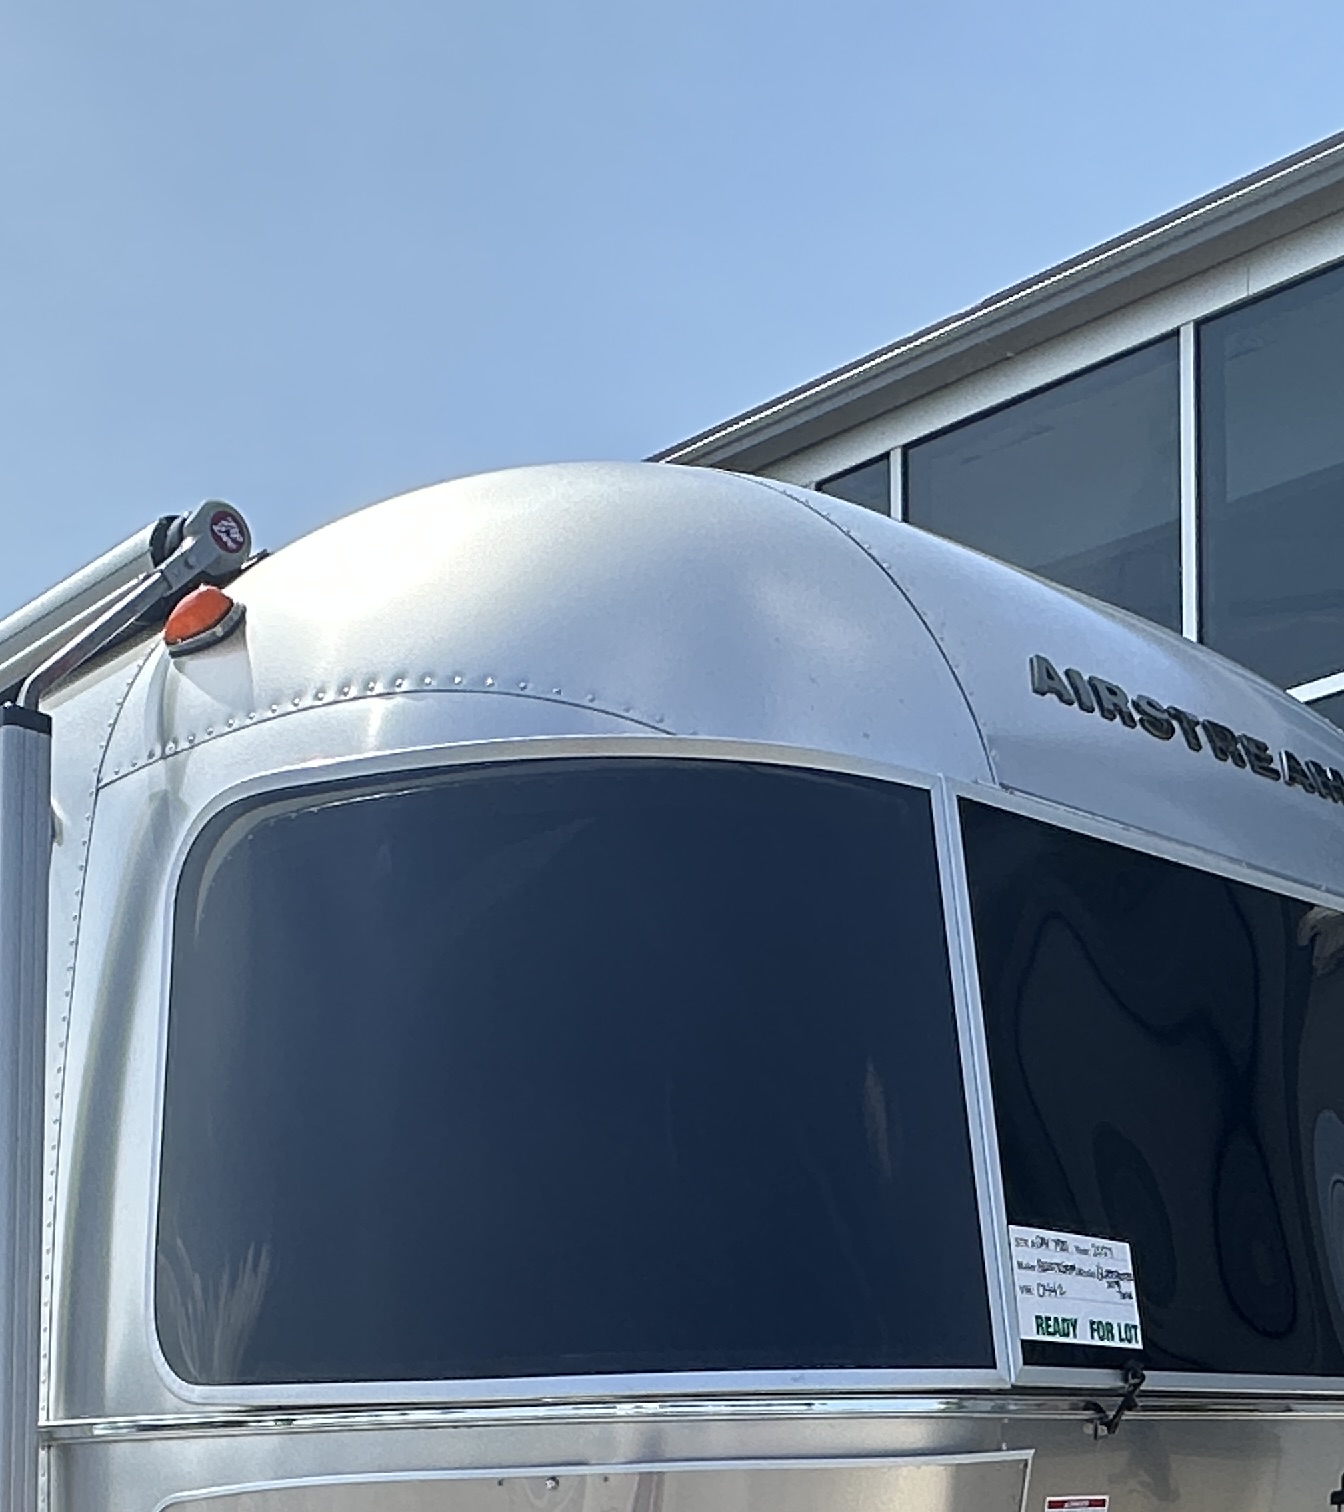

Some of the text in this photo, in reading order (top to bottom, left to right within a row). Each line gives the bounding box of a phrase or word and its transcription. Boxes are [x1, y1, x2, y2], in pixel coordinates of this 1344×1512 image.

[1035, 1315, 1140, 1344] READY FOR LOT
